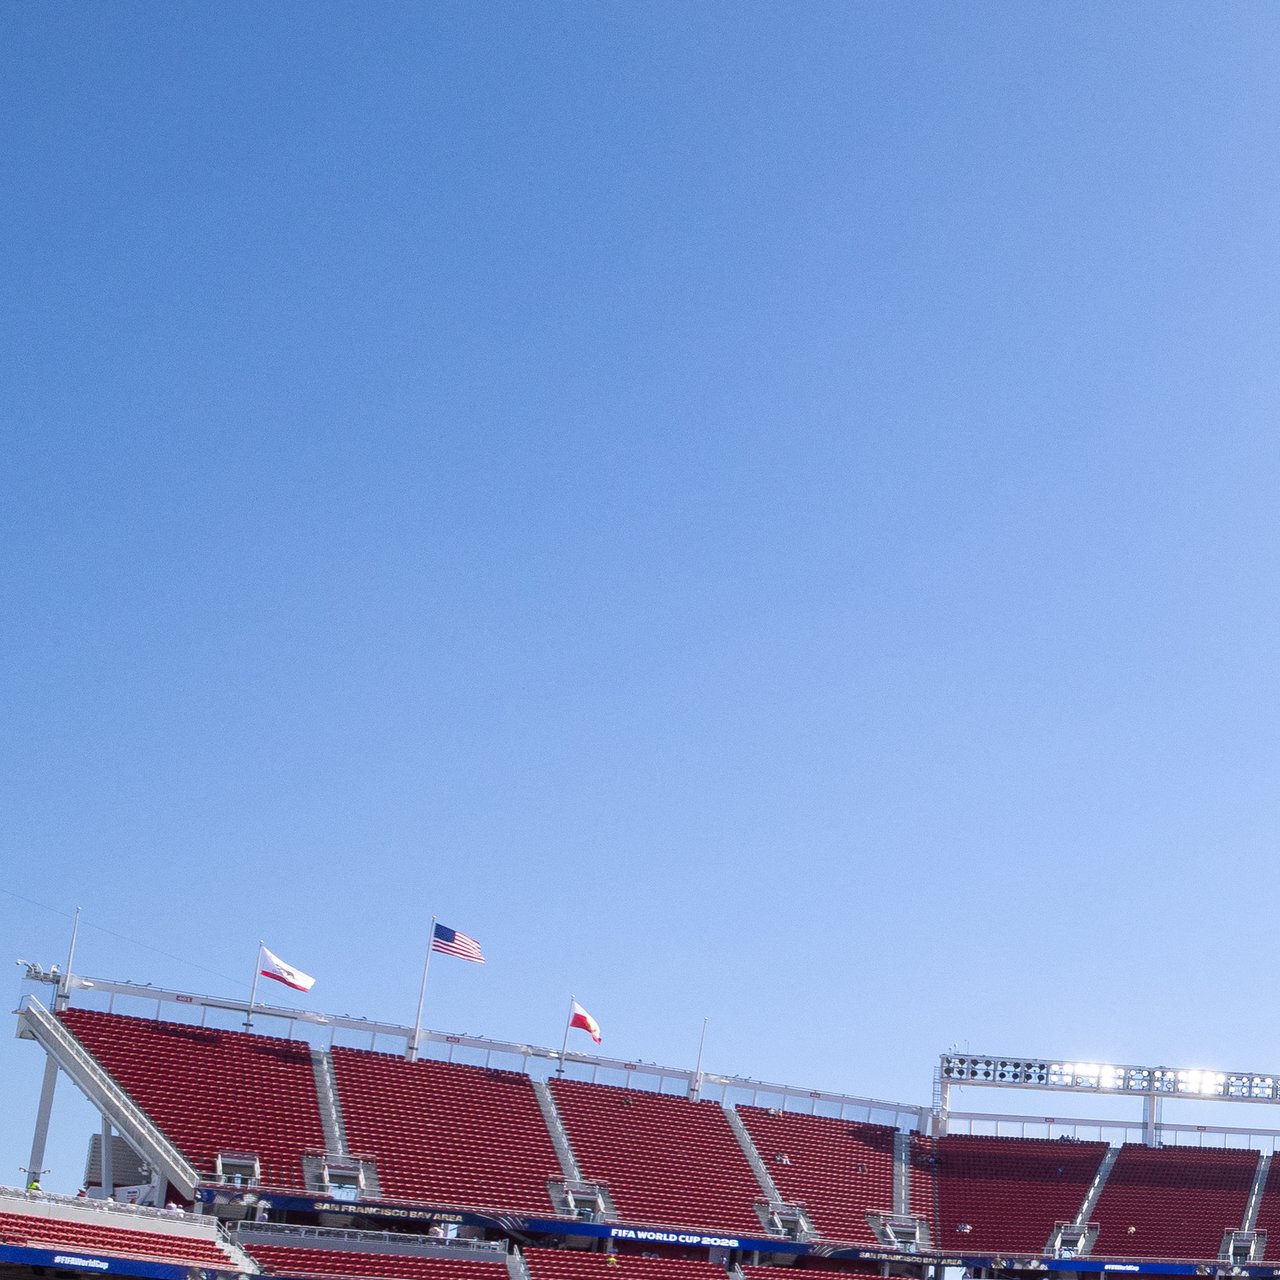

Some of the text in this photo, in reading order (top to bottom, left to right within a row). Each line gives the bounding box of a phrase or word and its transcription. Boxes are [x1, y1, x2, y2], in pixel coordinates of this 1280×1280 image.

[314, 1203, 462, 1222] SAN FRANCISCO BAY AREA
[611, 1229, 738, 1247] FIFA WORLD CUP 2026
